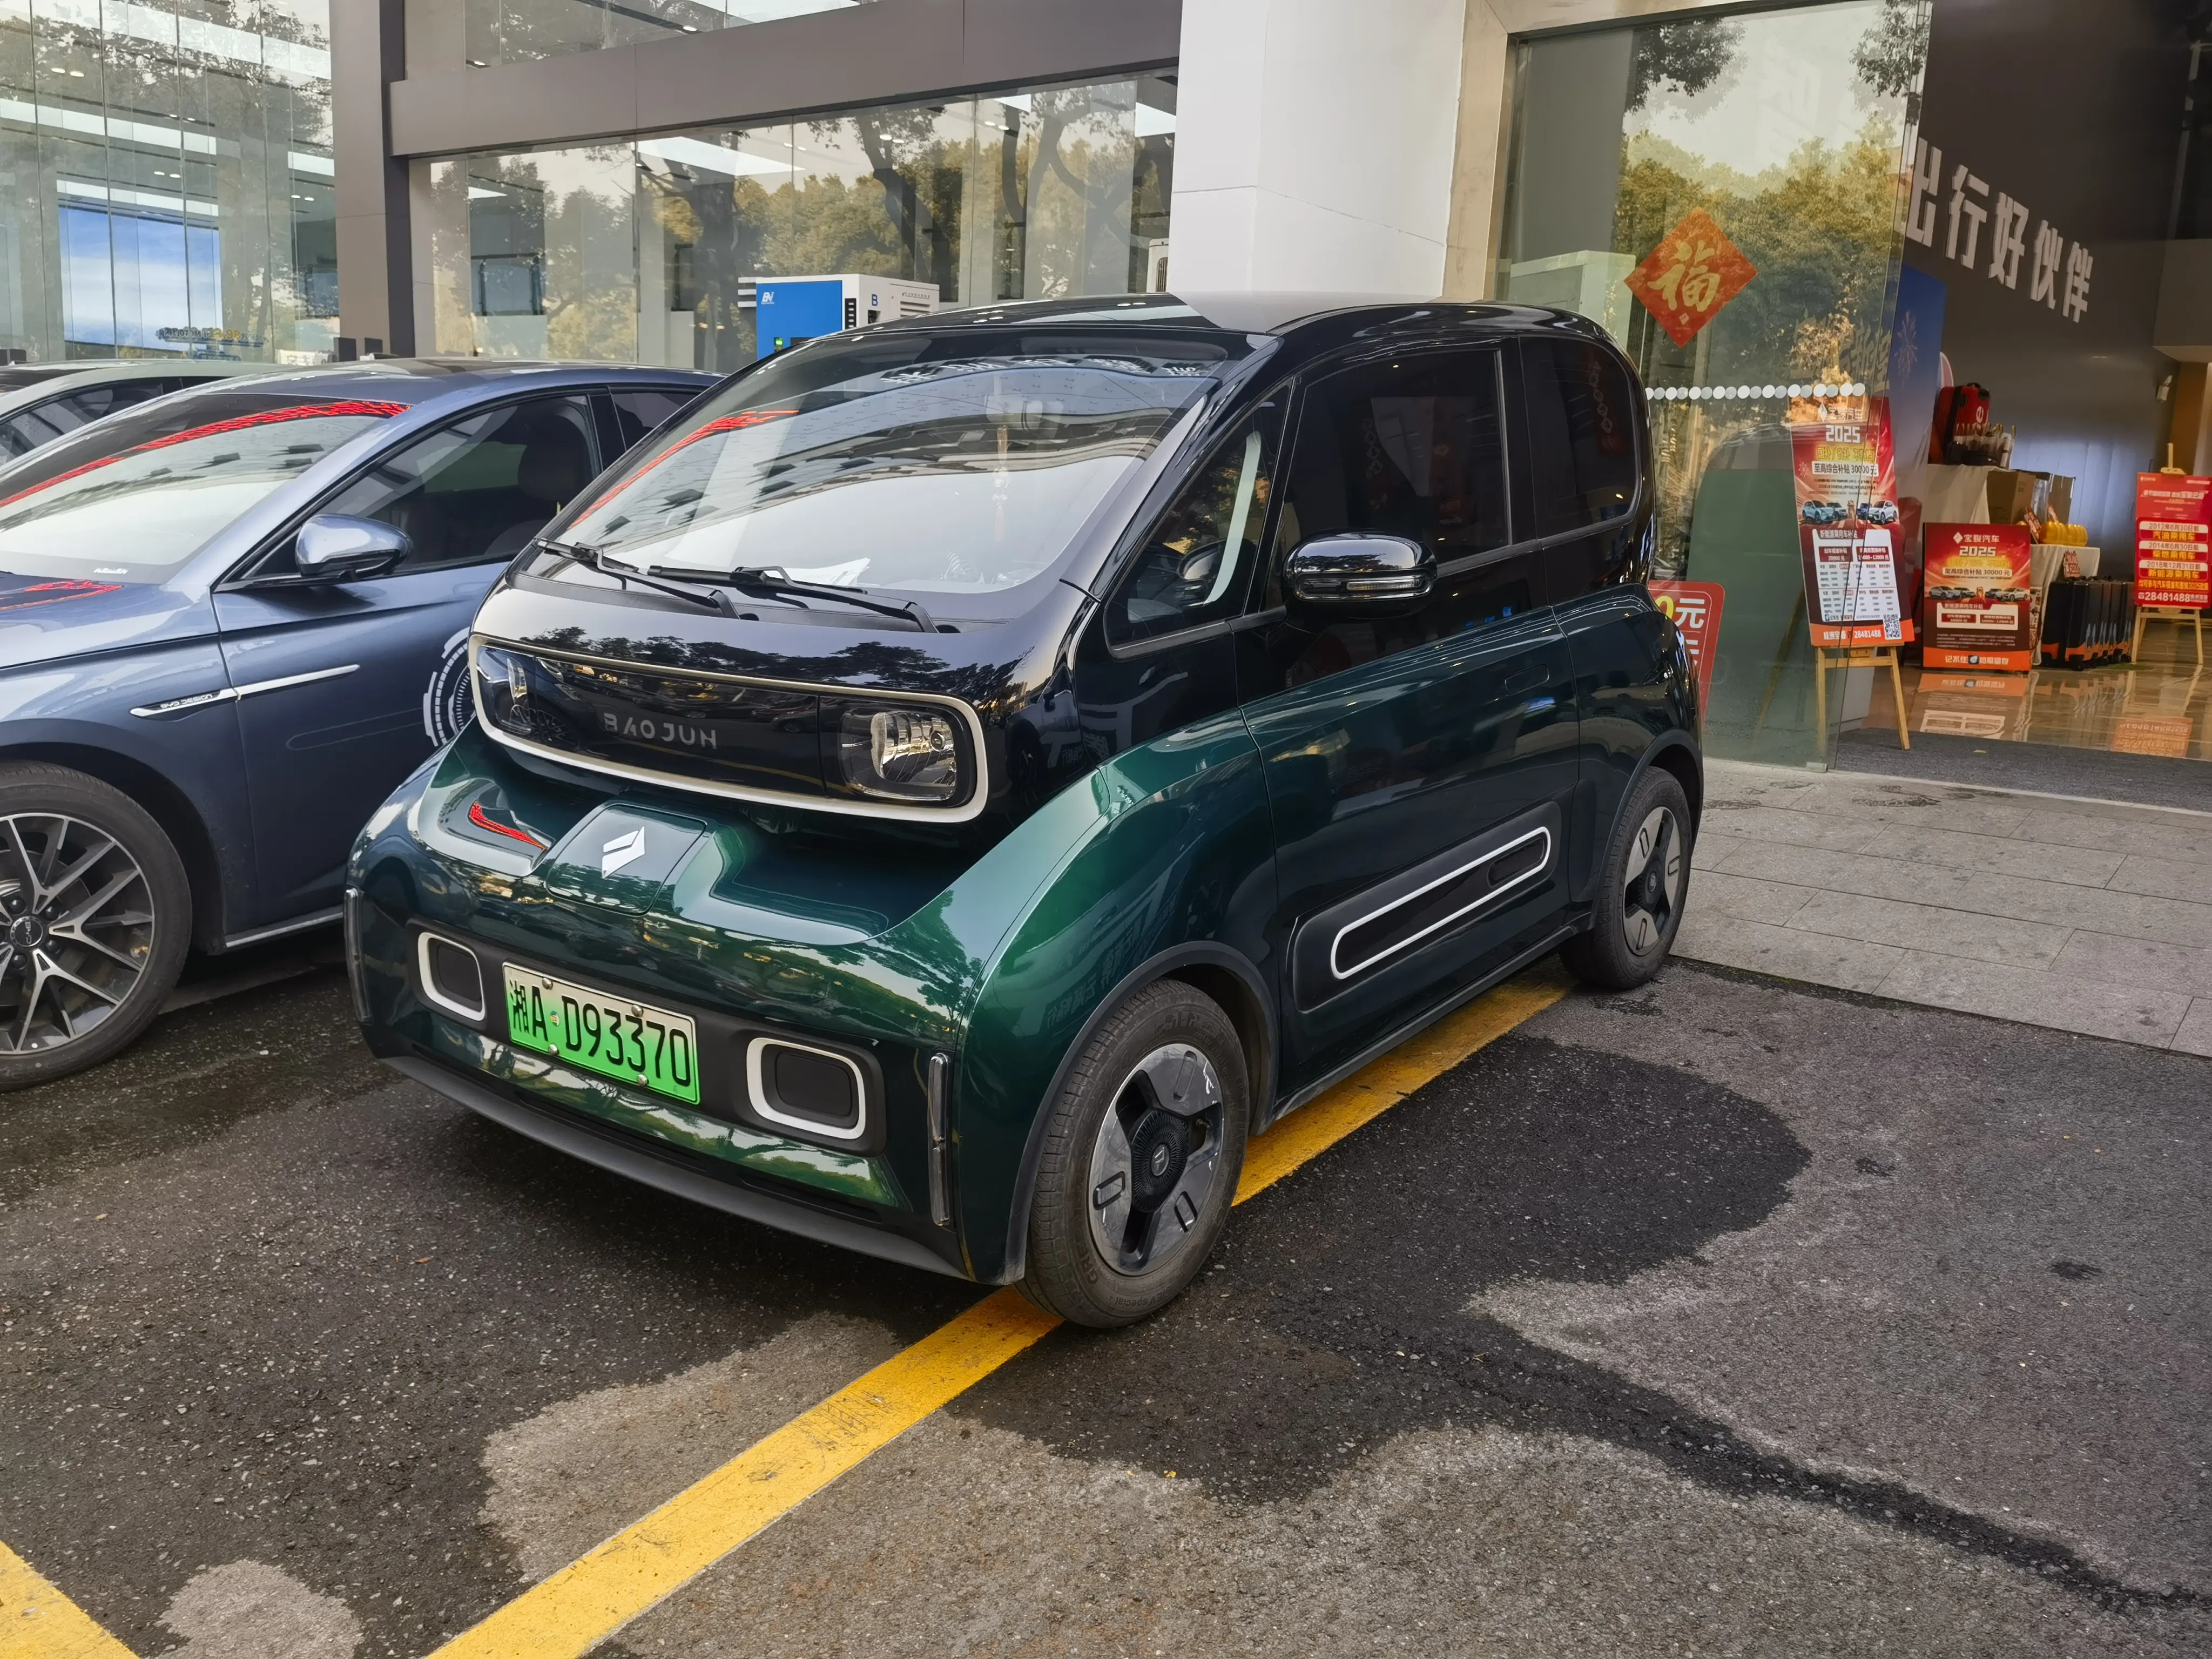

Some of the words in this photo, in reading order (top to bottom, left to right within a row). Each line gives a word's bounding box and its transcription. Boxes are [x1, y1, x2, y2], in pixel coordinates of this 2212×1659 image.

[1647, 240, 1721, 312] 福
[1825, 424, 1860, 443] 2025
[1964, 534, 2000, 543] 宝骏汽车
[1959, 545, 1997, 557] 2025
[2144, 592, 2190, 602] 28481488
[1854, 629, 1881, 638] 28481488
[181, 693, 213, 705] DESIGN
[603, 711, 718, 750] BAOJUN
